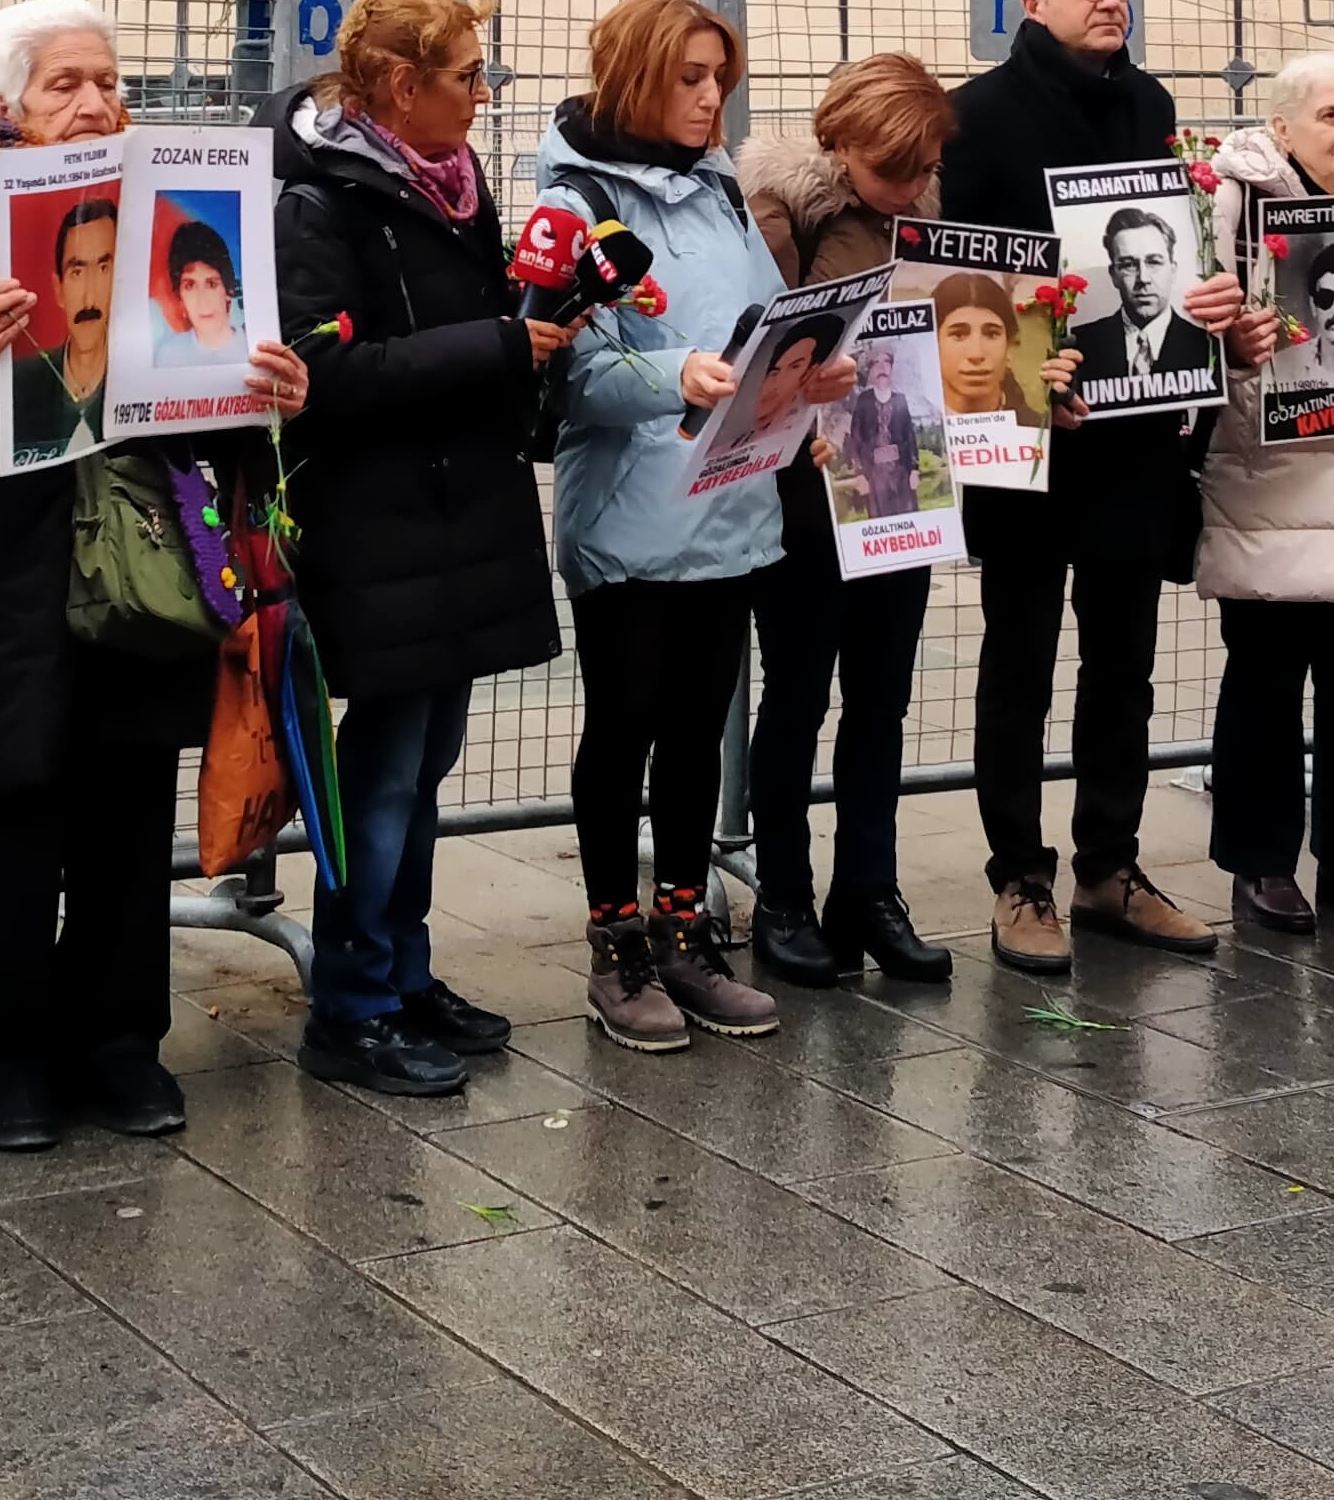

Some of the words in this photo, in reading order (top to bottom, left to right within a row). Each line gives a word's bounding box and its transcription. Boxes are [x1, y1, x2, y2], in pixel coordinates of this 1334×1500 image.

[151, 147, 204, 165] ZOZAN
[207, 148, 250, 167] EREN
[1055, 170, 1158, 201] SABAHATTİN
[519, 248, 555, 269] anka
[927, 227, 999, 264] YETER
[1005, 237, 1050, 272] IŞIK
[767, 288, 838, 321] MURAT
[835, 271, 893, 305] YILDIZ
[877, 309, 928, 331] CÜLAZ
[1082, 367, 1218, 406] UNUTMADIK
[113, 401, 152, 425] 1997'DE
[154, 396, 214, 422] GÖZALTINDA
[956, 414, 1006, 427] Dersim'de
[861, 519, 916, 537] GÖZALTINDA
[862, 525, 942, 558] KAYBEDİLDİ
